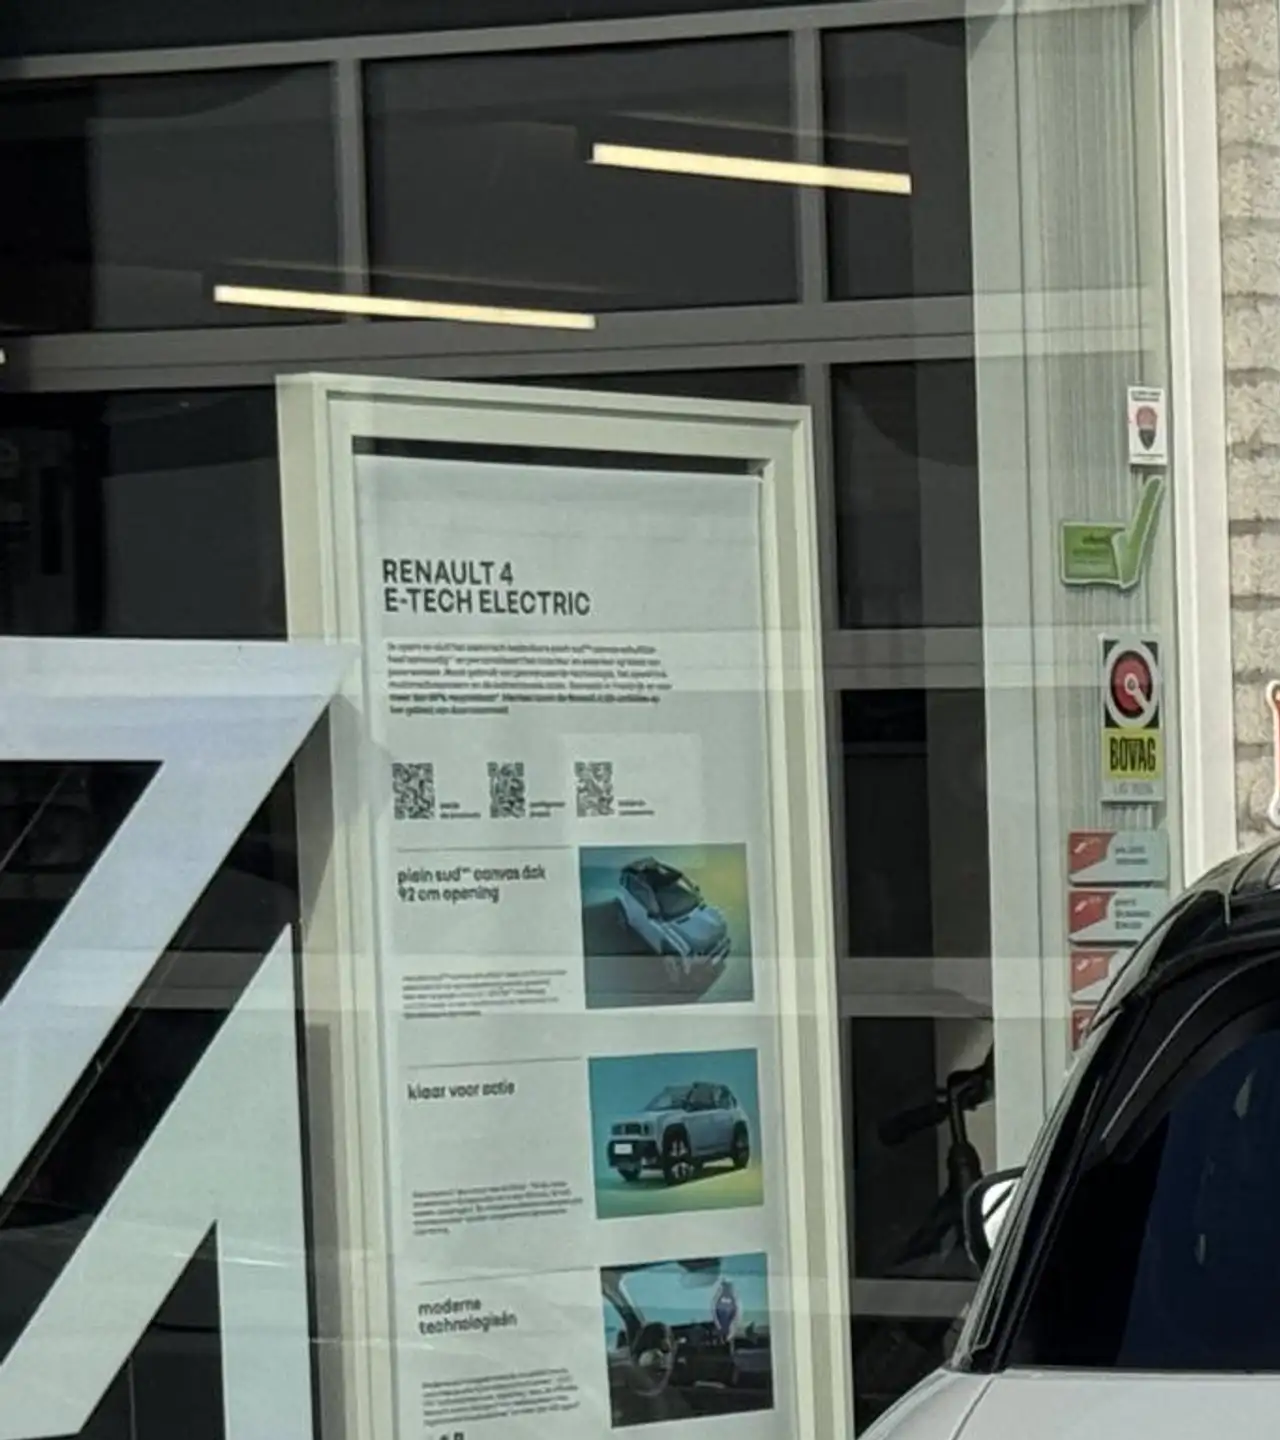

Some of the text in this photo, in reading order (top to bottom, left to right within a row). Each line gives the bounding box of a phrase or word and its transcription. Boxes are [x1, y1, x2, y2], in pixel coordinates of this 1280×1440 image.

[382, 558, 514, 587] RENAULT 4
[384, 587, 591, 616] E-TECH ELECTRIC
[1109, 736, 1156, 772] BOVAG
[397, 866, 433, 885] plein
[418, 887, 441, 901] cm
[443, 886, 500, 904] opening
[407, 1082, 446, 1100] klaar
[449, 1084, 480, 1098] voor
[418, 1299, 481, 1316] moderne
